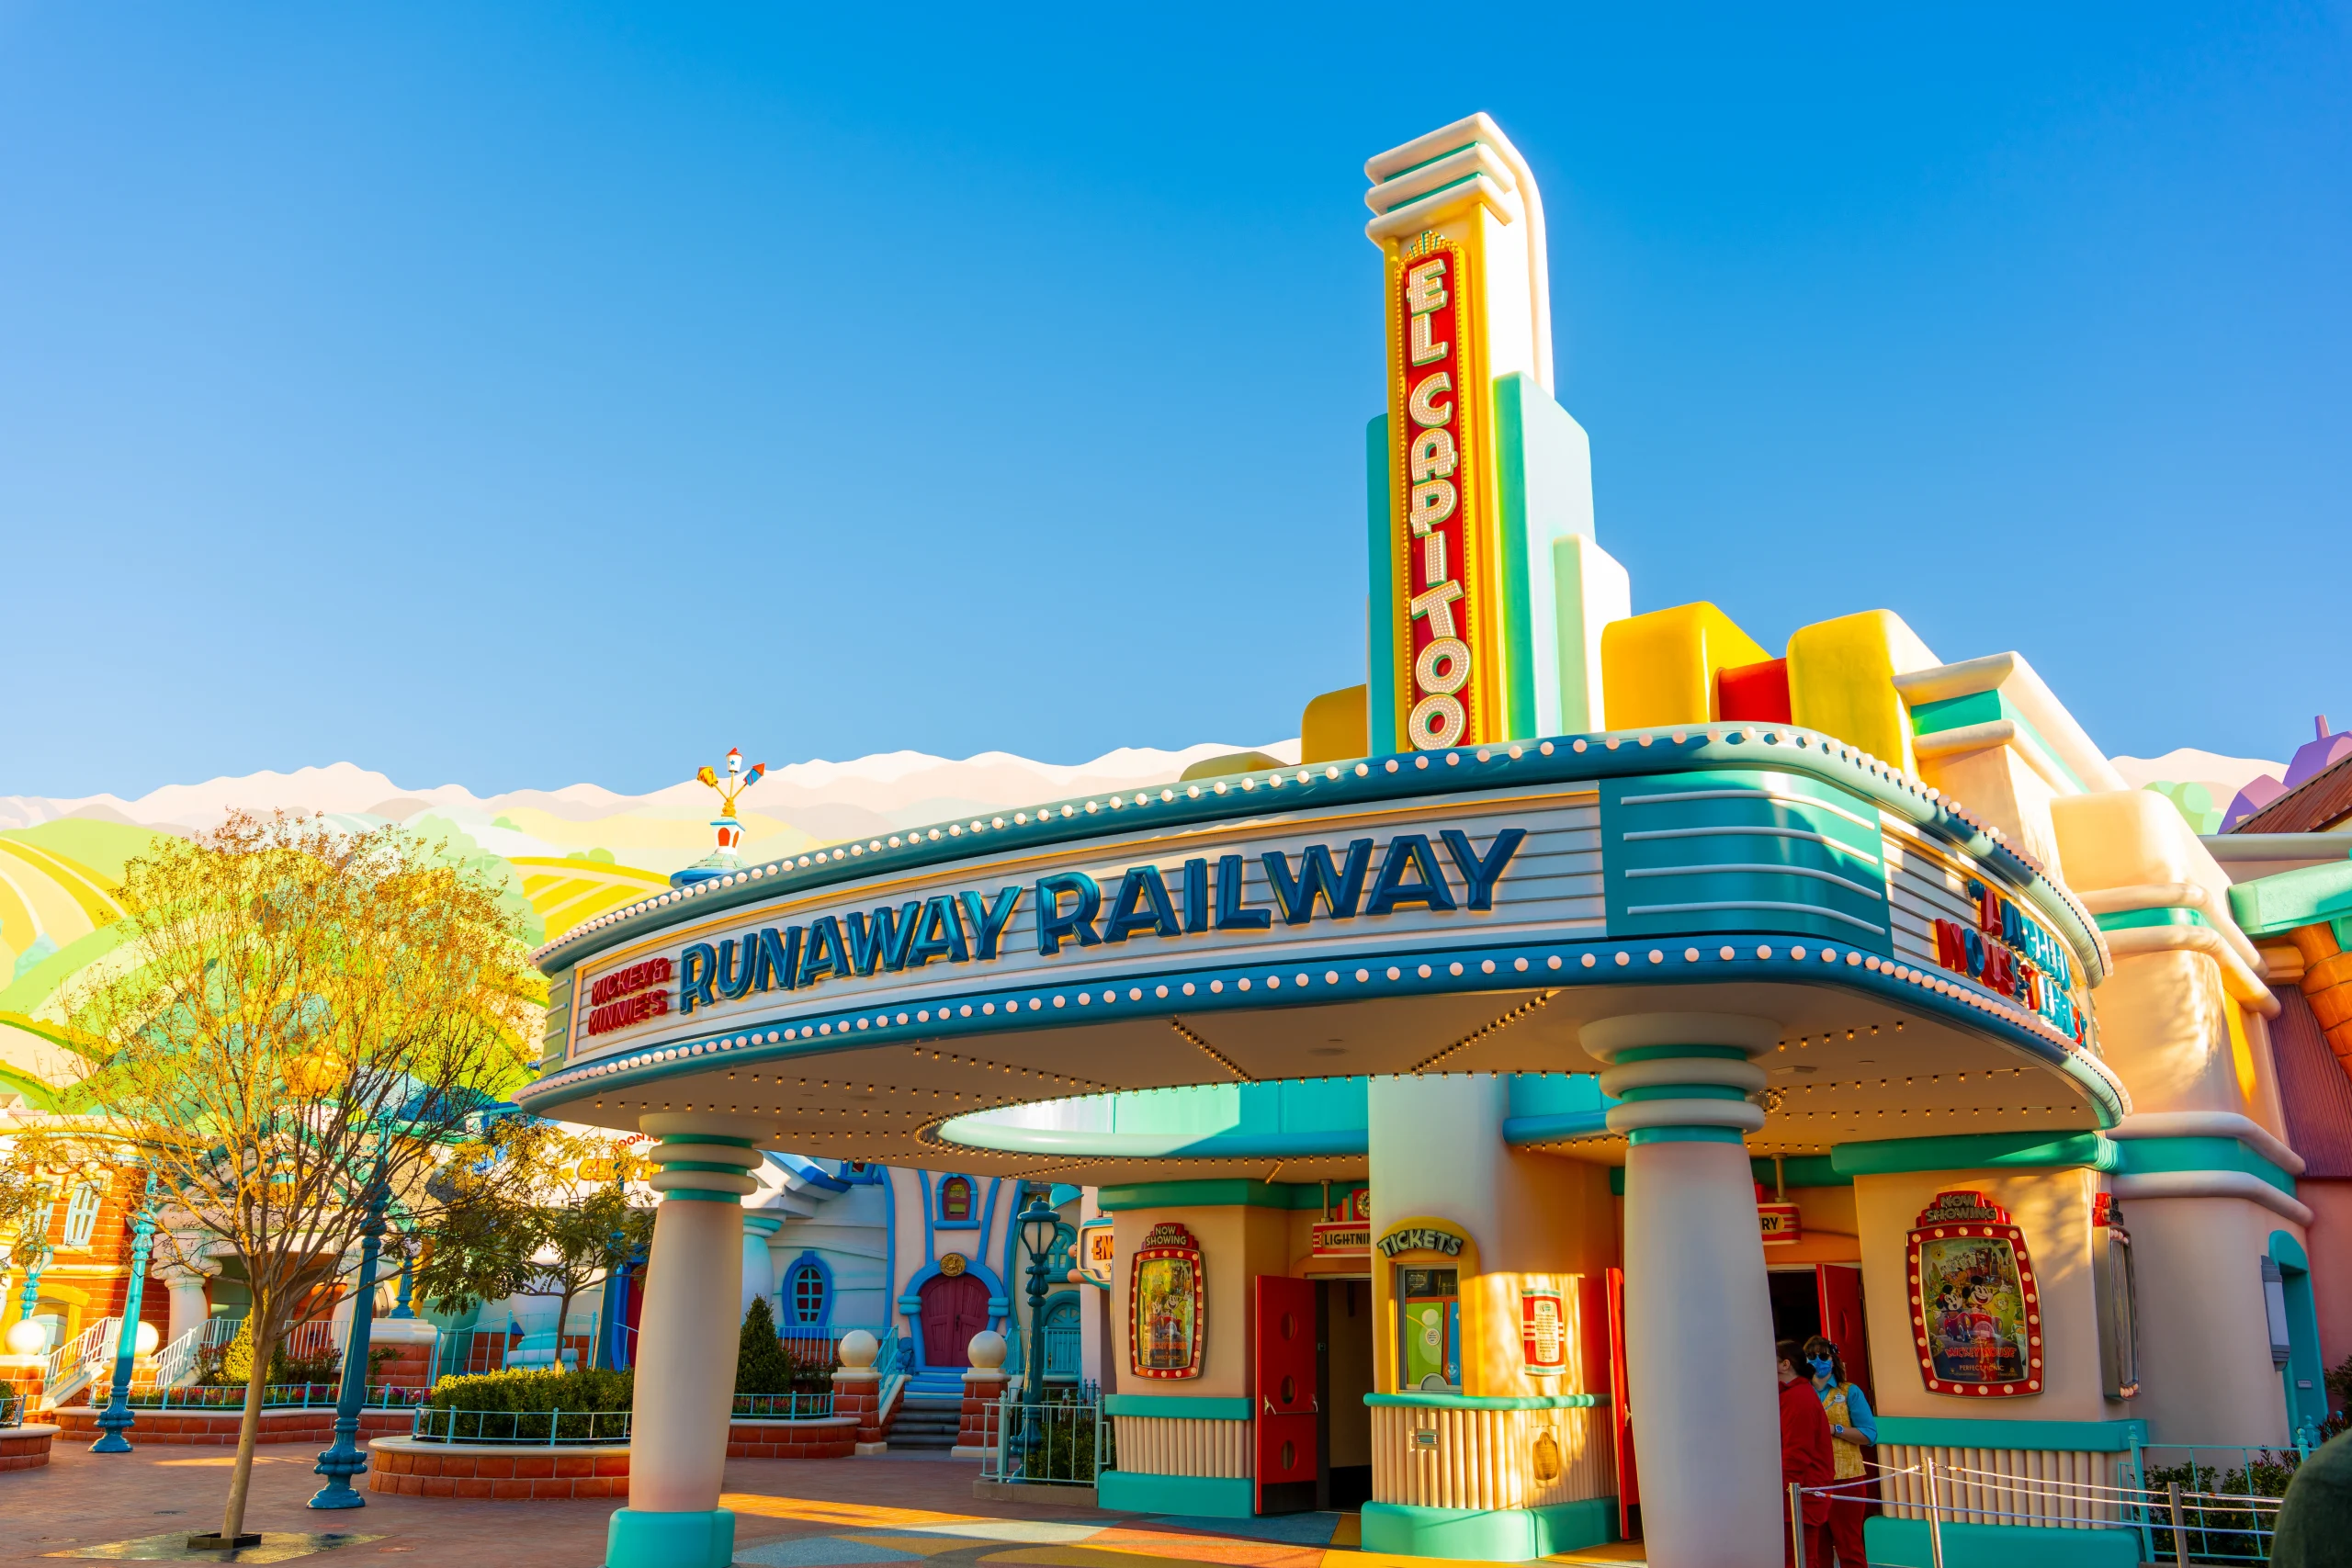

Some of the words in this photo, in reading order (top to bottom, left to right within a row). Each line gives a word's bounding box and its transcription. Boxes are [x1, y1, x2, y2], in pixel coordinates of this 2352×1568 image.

[680, 886, 1023, 1015] RUNAWAY
[1036, 828, 1528, 956] RAILWAY
[588, 989, 668, 1036] MINNIE'S
[1940, 1194, 1978, 1208] NOW
[1926, 1207, 1997, 1223] SHOWING
[1155, 1225, 1177, 1236] NOW
[1759, 1217, 1779, 1230] RY
[1146, 1235, 1187, 1247] SHOWING
[1377, 1229, 1464, 1258] TICKETS
[1945, 1347, 1981, 1359] MICKEY
[1982, 1347, 2018, 1359] MOUSE
